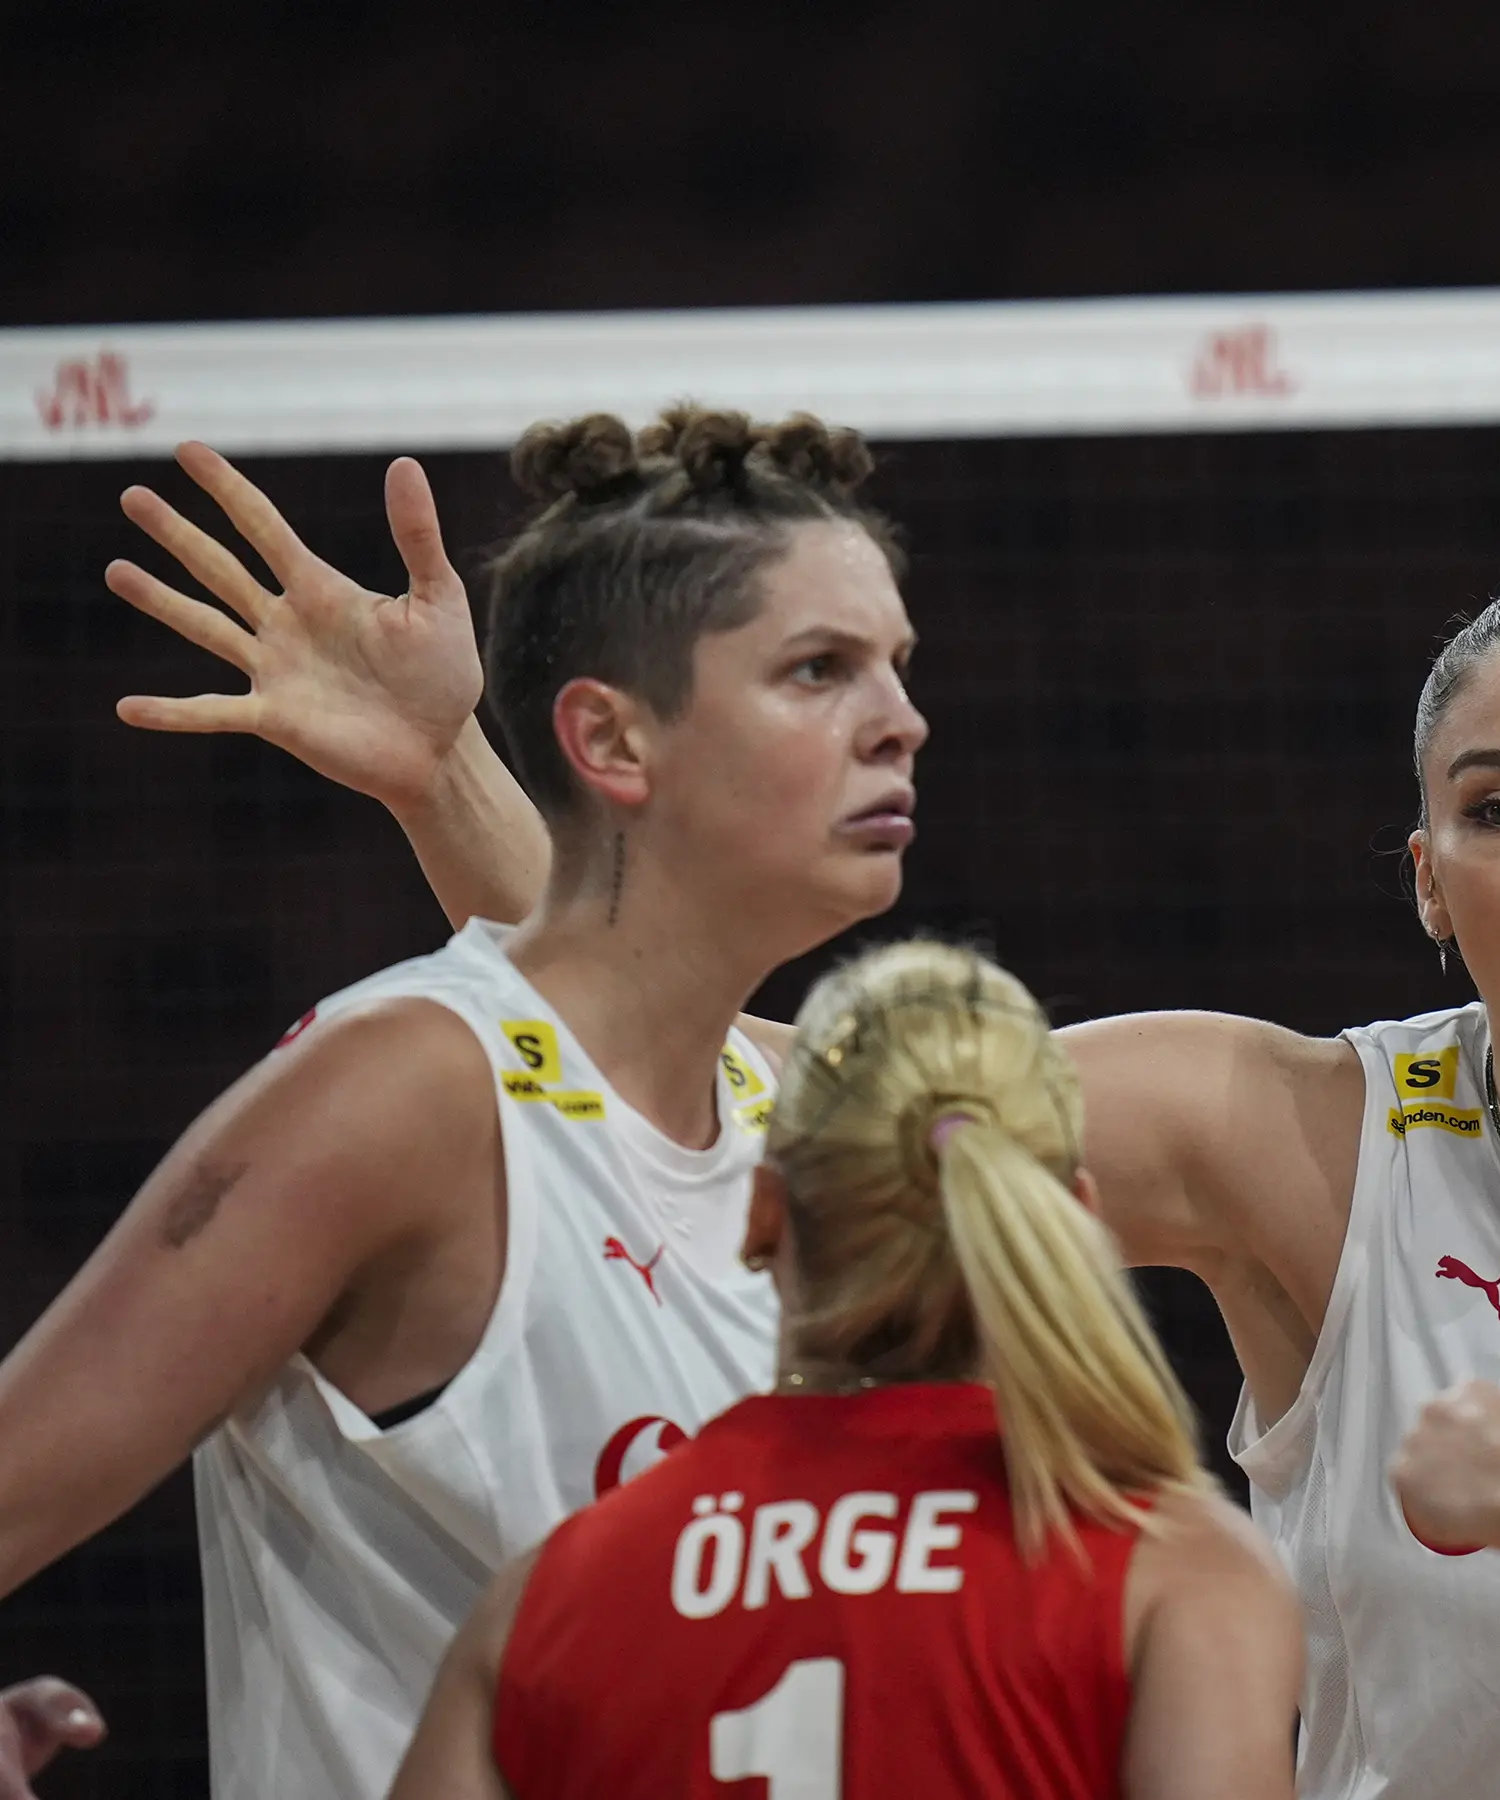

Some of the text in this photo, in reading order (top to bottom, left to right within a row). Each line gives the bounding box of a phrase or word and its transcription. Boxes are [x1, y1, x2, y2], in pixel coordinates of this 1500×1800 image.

[514, 1034, 543, 1069] S
[1405, 1059, 1441, 1089] S
[670, 1490, 979, 1620] ÖRGE
[710, 1656, 845, 1800] 1
